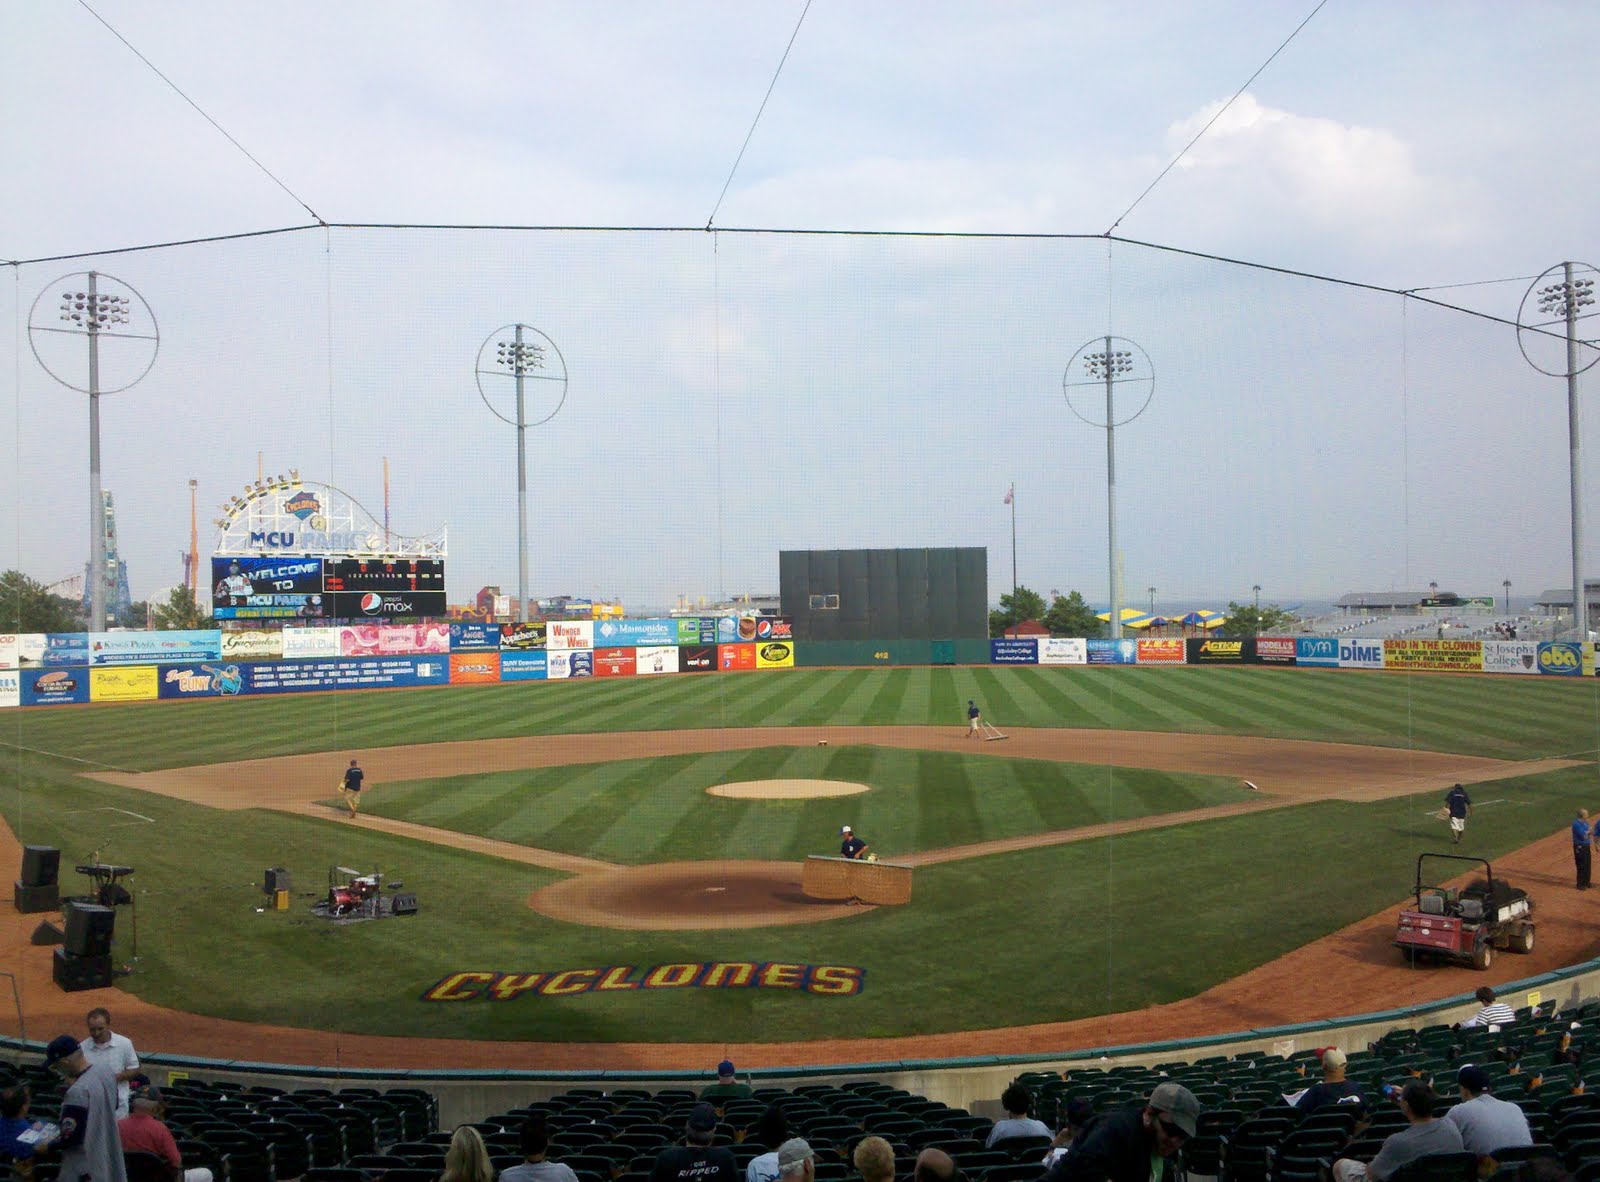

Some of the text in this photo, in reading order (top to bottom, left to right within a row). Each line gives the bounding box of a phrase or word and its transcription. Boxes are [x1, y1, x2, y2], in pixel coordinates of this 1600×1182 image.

[251, 531, 294, 547] MCU
[242, 563, 319, 580] WELCOME
[272, 580, 294, 590] TO
[384, 603, 412, 612] max
[553, 624, 580, 637] WONDER
[619, 623, 669, 633] Maimonides
[500, 630, 538, 645] Applebee's
[567, 636, 589, 648] WHEEL
[1200, 640, 1243, 652] ACTION
[1384, 639, 1482, 651] SEND IN THE CLOWNS
[687, 659, 710, 667] verizon
[1385, 660, 1482, 670] SENDINTHECLOWNS.COM
[1485, 653, 1522, 667] College
[180, 676, 210, 691] CUNY
[419, 963, 868, 1001] CYCLONES
[678, 1165, 720, 1178] RIPPED
